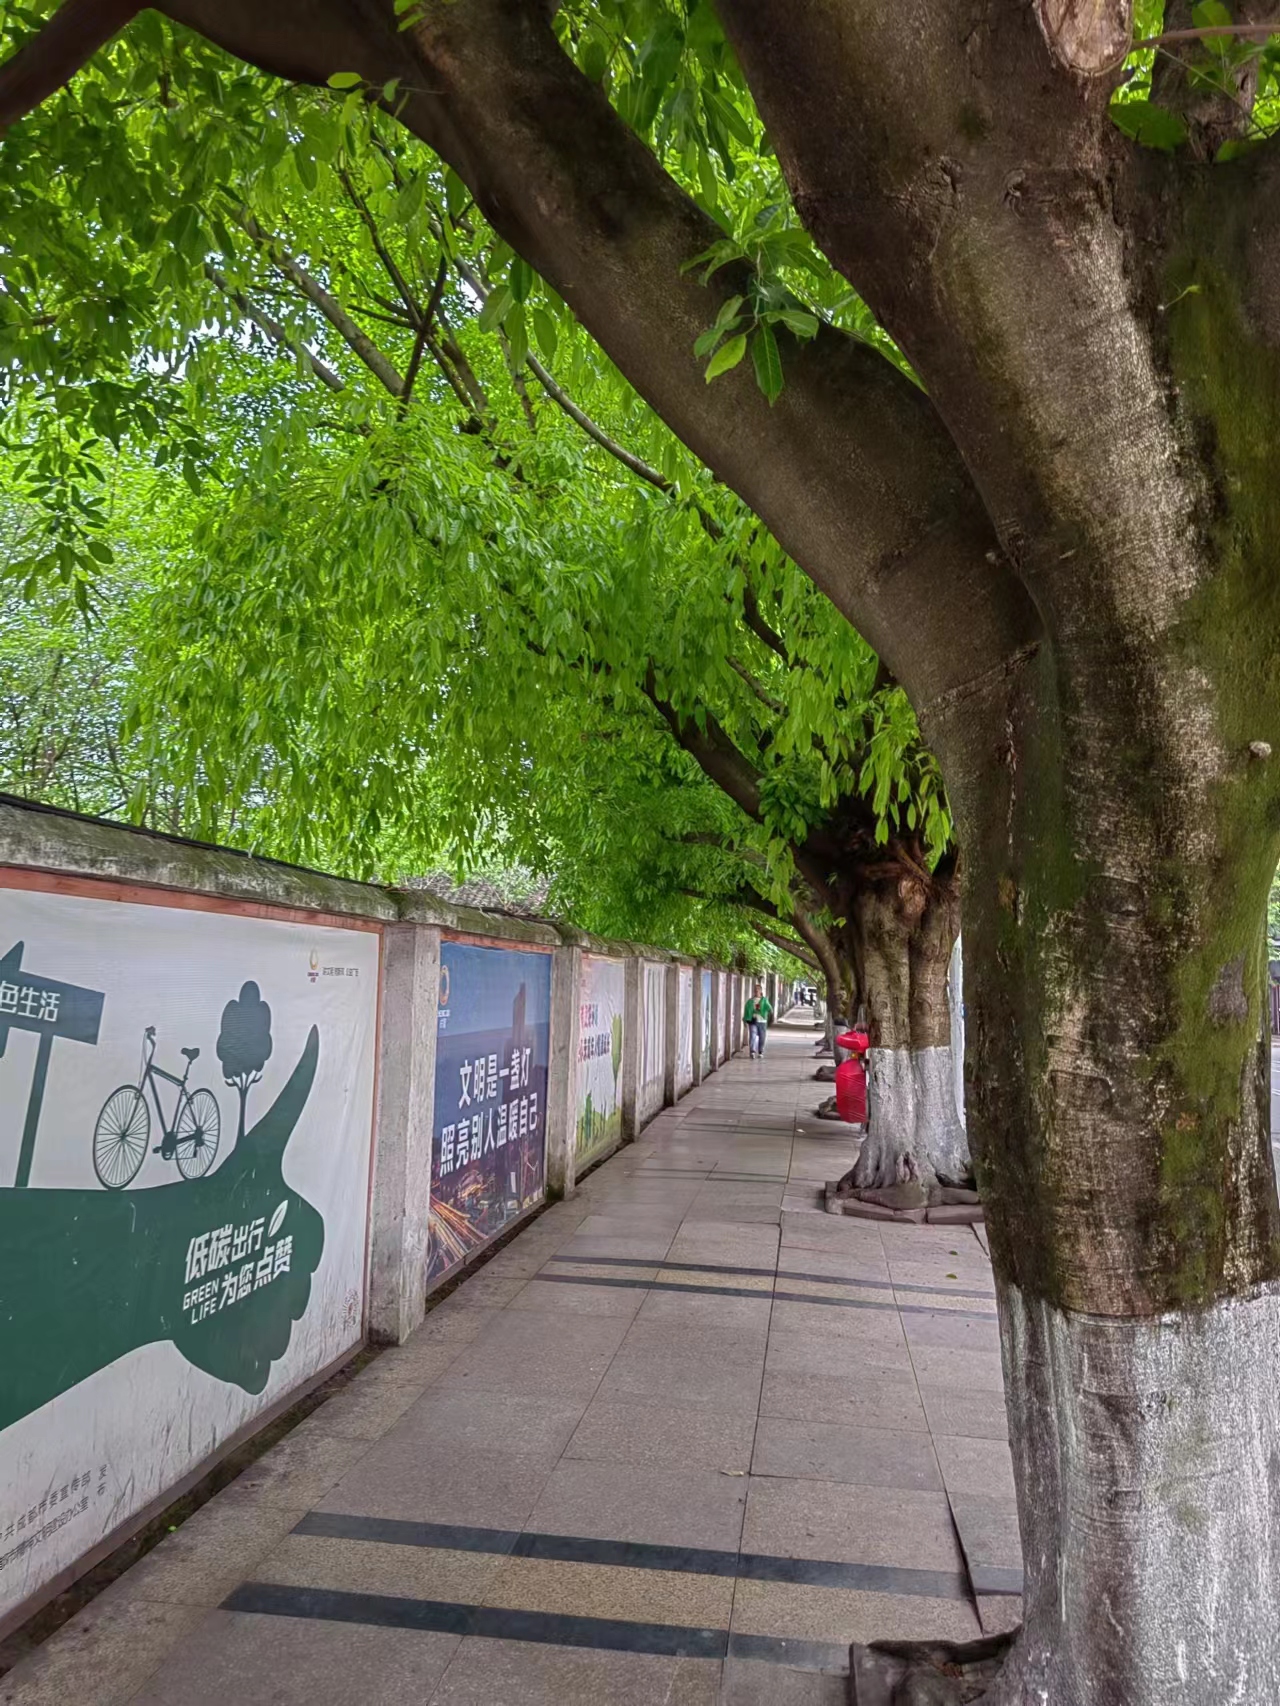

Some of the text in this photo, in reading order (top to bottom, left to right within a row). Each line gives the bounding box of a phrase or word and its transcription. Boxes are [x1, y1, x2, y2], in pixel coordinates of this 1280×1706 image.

[458, 1047, 531, 1108] 文明是一盏灯
[440, 1092, 538, 1177] 照亮别人温暖自己
[184, 1217, 265, 1284] 低碳出行
[218, 1235, 293, 1310] 为您点赞
[182, 1278, 220, 1311] GREEN
[191, 1297, 217, 1325] LIFE
